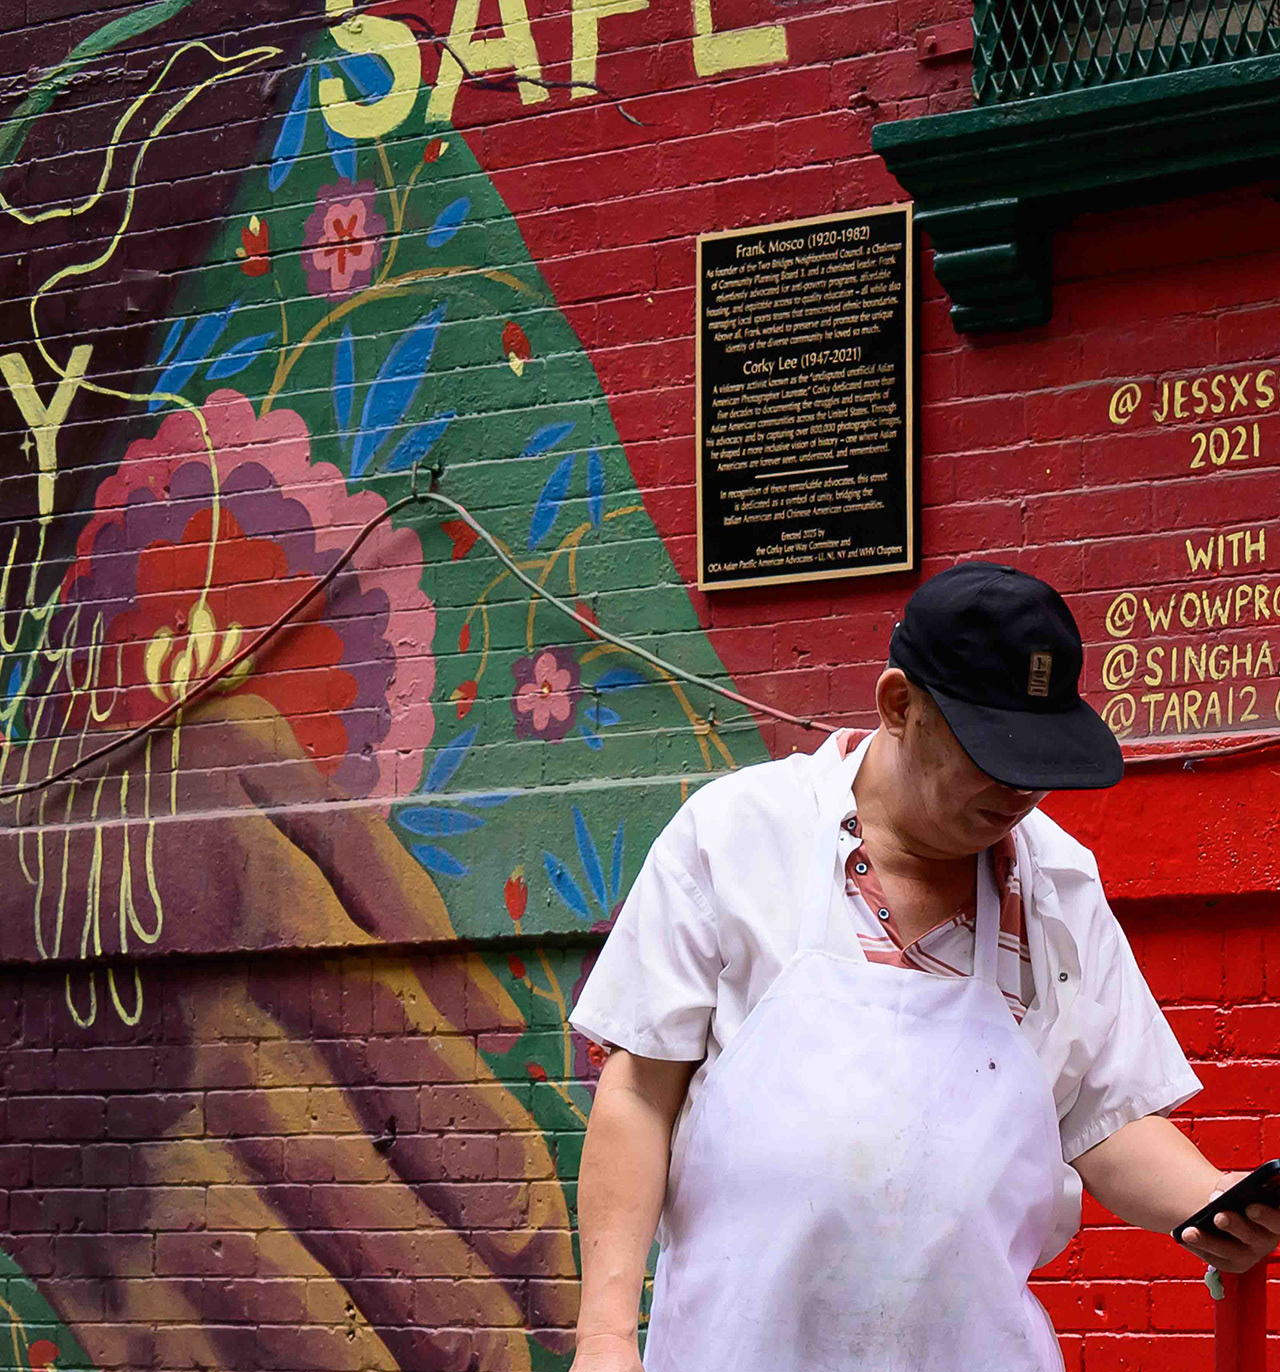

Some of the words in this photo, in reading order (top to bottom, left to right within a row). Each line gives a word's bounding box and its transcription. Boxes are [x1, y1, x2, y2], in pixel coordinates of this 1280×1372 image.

[736, 241, 765, 258] Frank
[768, 239, 804, 253] Mosco
[808, 226, 870, 248] (1920-1982)
[743, 358, 775, 375] Corky
[779, 357, 798, 370] Lee
[801, 347, 861, 369] (1947-2021)
[1189, 422, 1260, 469] 2021
[1185, 529, 1266, 571] WITH
